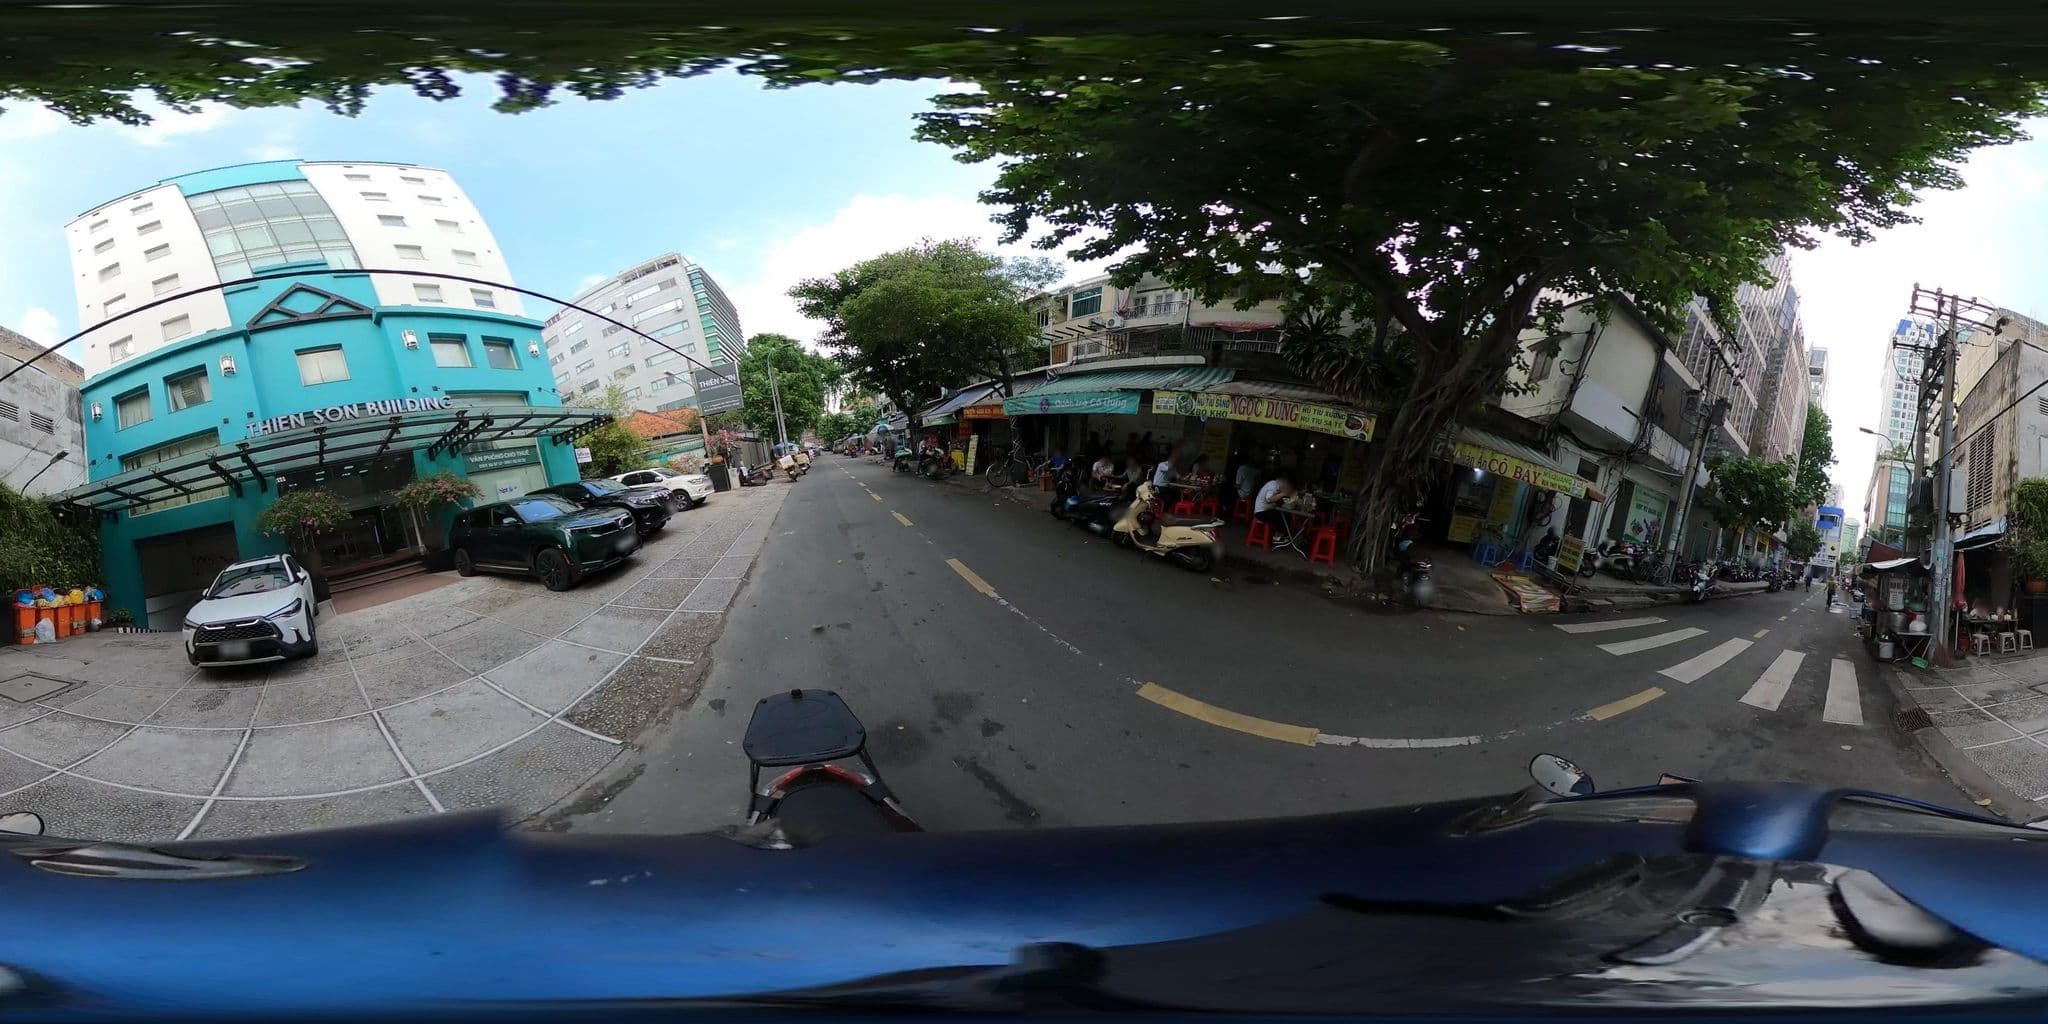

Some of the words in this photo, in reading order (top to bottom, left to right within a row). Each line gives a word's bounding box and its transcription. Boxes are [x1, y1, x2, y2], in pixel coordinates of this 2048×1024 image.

[246, 412, 306, 438] THIEN
[313, 403, 360, 424] SON
[366, 395, 454, 416] BUILDING
[1488, 457, 1508, 475] CÔ
